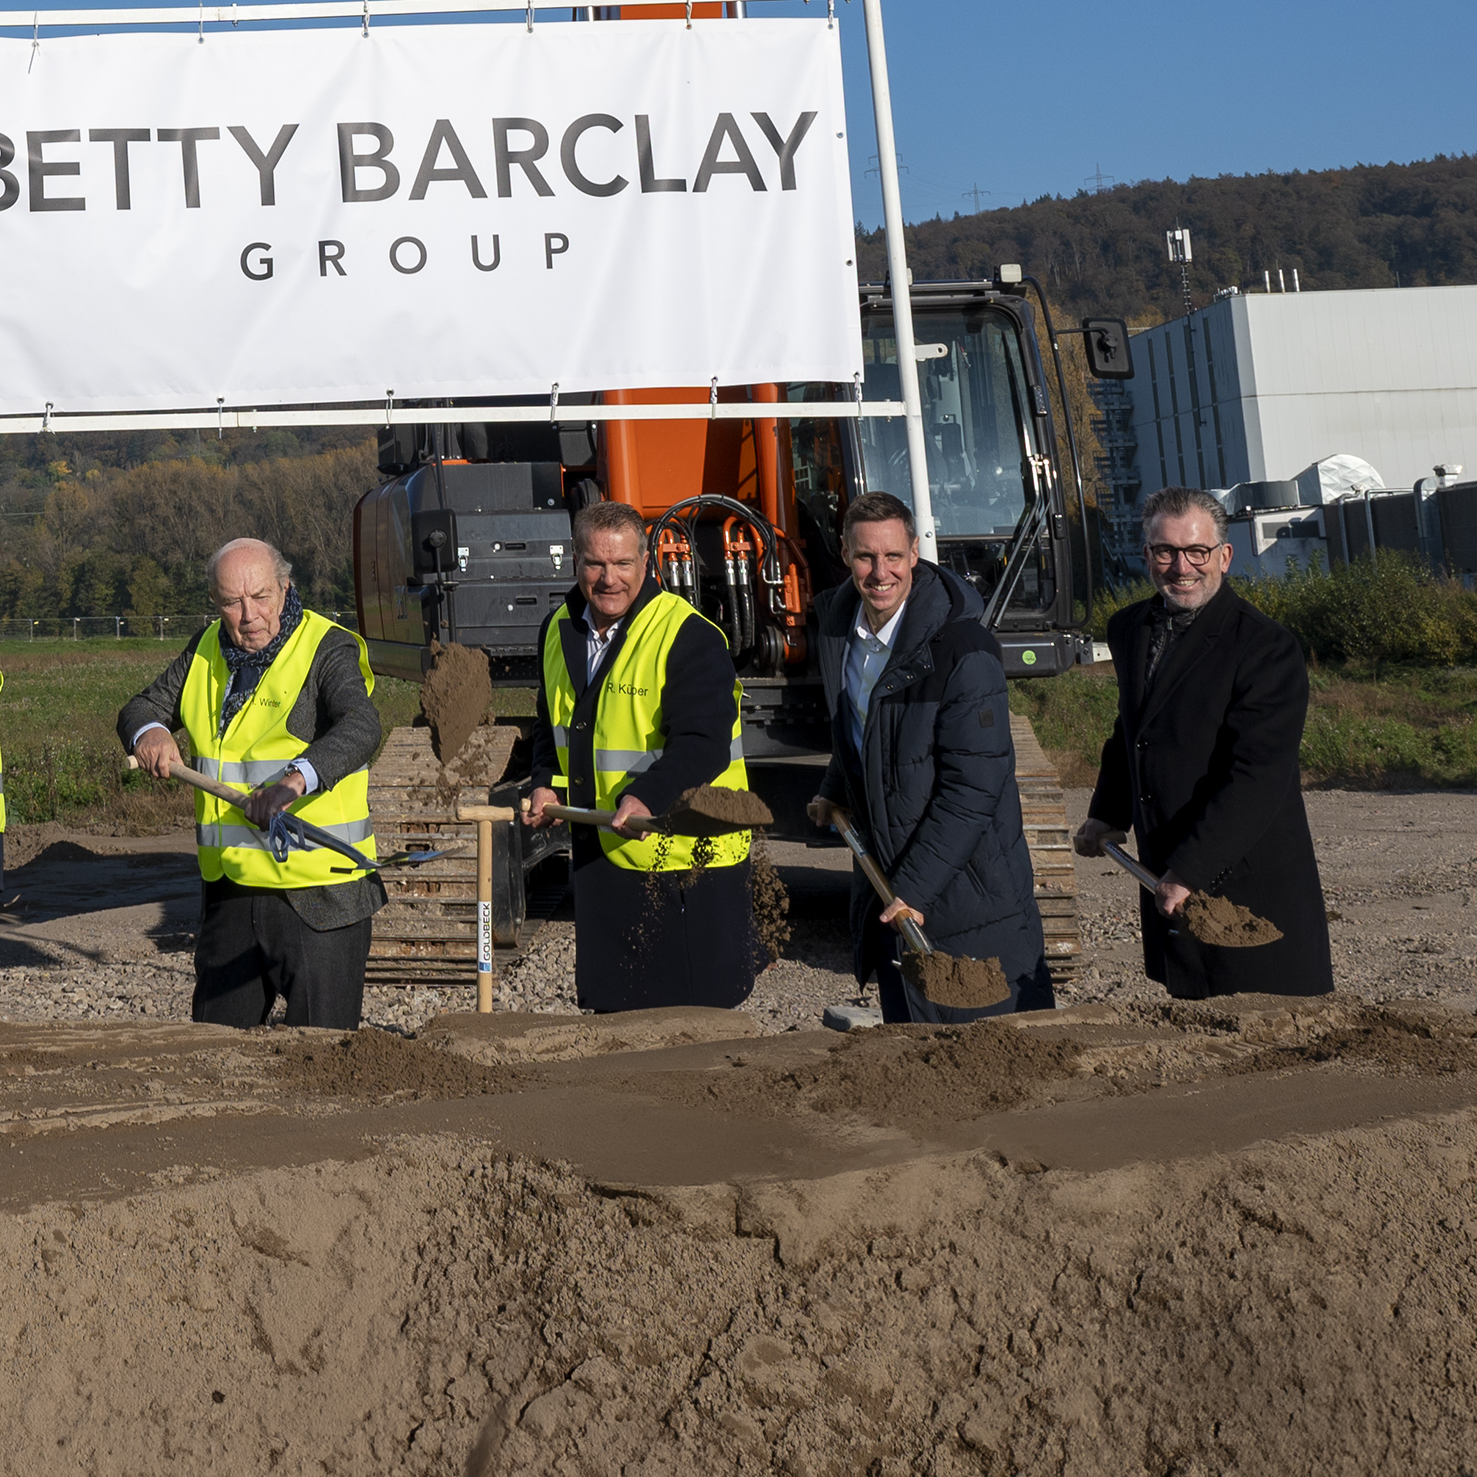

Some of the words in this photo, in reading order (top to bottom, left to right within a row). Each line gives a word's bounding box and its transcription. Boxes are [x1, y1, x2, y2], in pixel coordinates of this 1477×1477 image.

[337, 111, 818, 203] BARCLAY
[240, 233, 569, 281] GROUP
[260, 697, 281, 708] Winter
[482, 903, 491, 961] GOLDBECK
